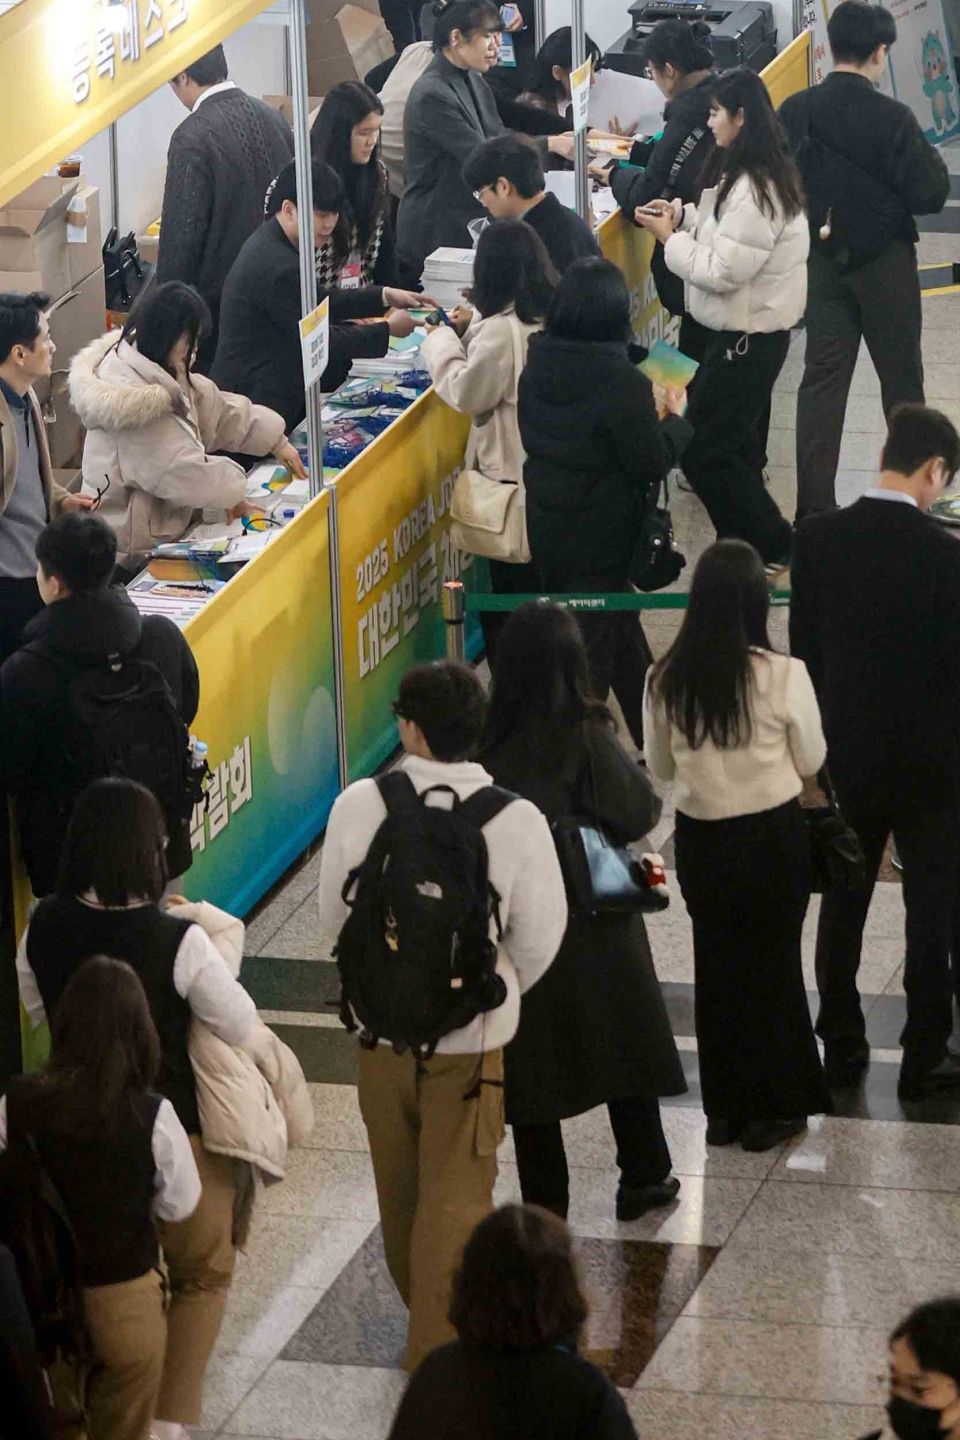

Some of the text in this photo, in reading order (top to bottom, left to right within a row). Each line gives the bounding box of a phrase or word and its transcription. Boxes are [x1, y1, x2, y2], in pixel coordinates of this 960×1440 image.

[357, 538, 390, 602] 2025
[393, 494, 436, 563] KOREA
[358, 542, 437, 679] 대한민국
